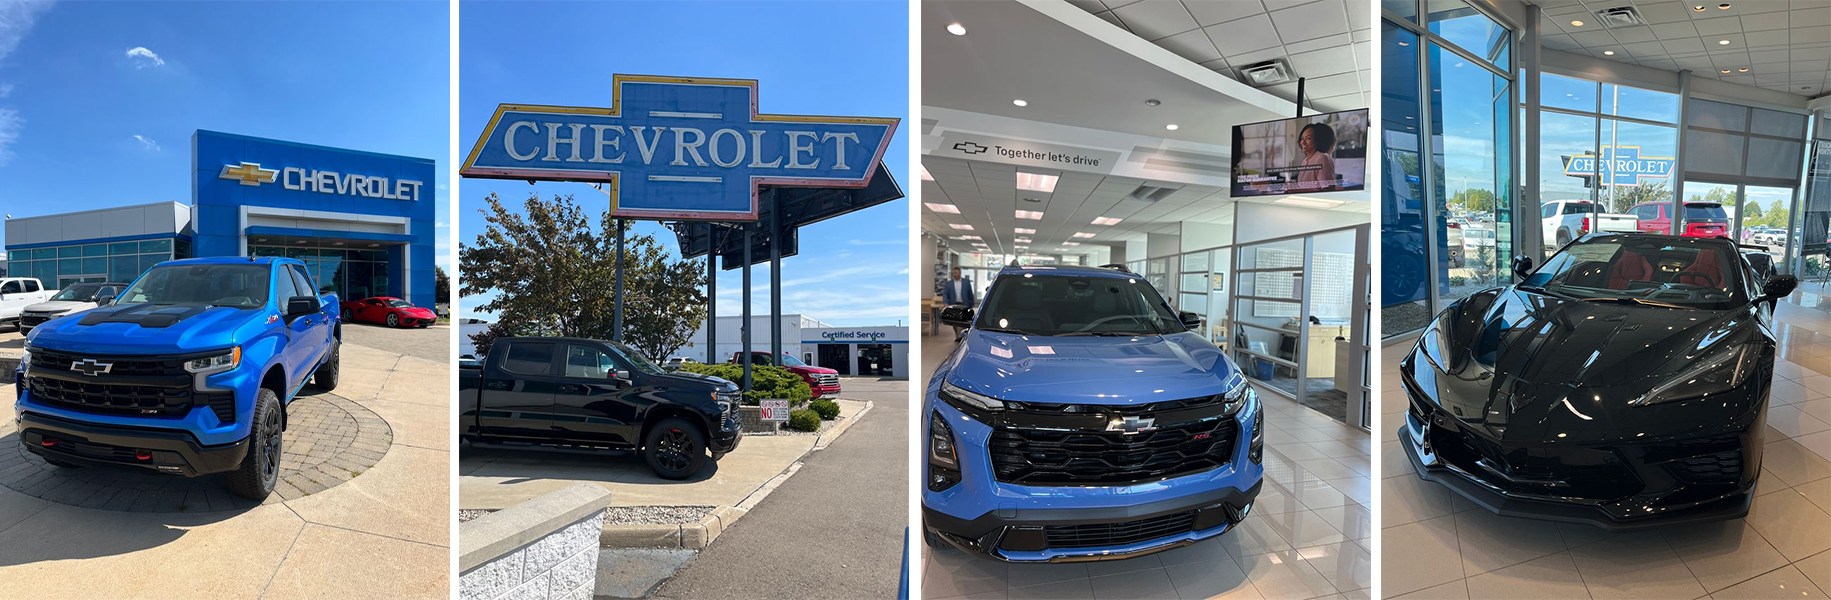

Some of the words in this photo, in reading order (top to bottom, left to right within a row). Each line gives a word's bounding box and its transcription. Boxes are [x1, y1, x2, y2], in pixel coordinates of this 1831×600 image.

[504, 120, 860, 170] CHEVROLET
[994, 145, 1046, 160] Together
[1049, 151, 1071, 163] let's
[1573, 159, 1668, 173] CHEVROLET
[283, 166, 423, 201] CHEVROLET
[821, 331, 854, 339] Certified
[856, 331, 886, 339] Service
[761, 407, 773, 419] NO
